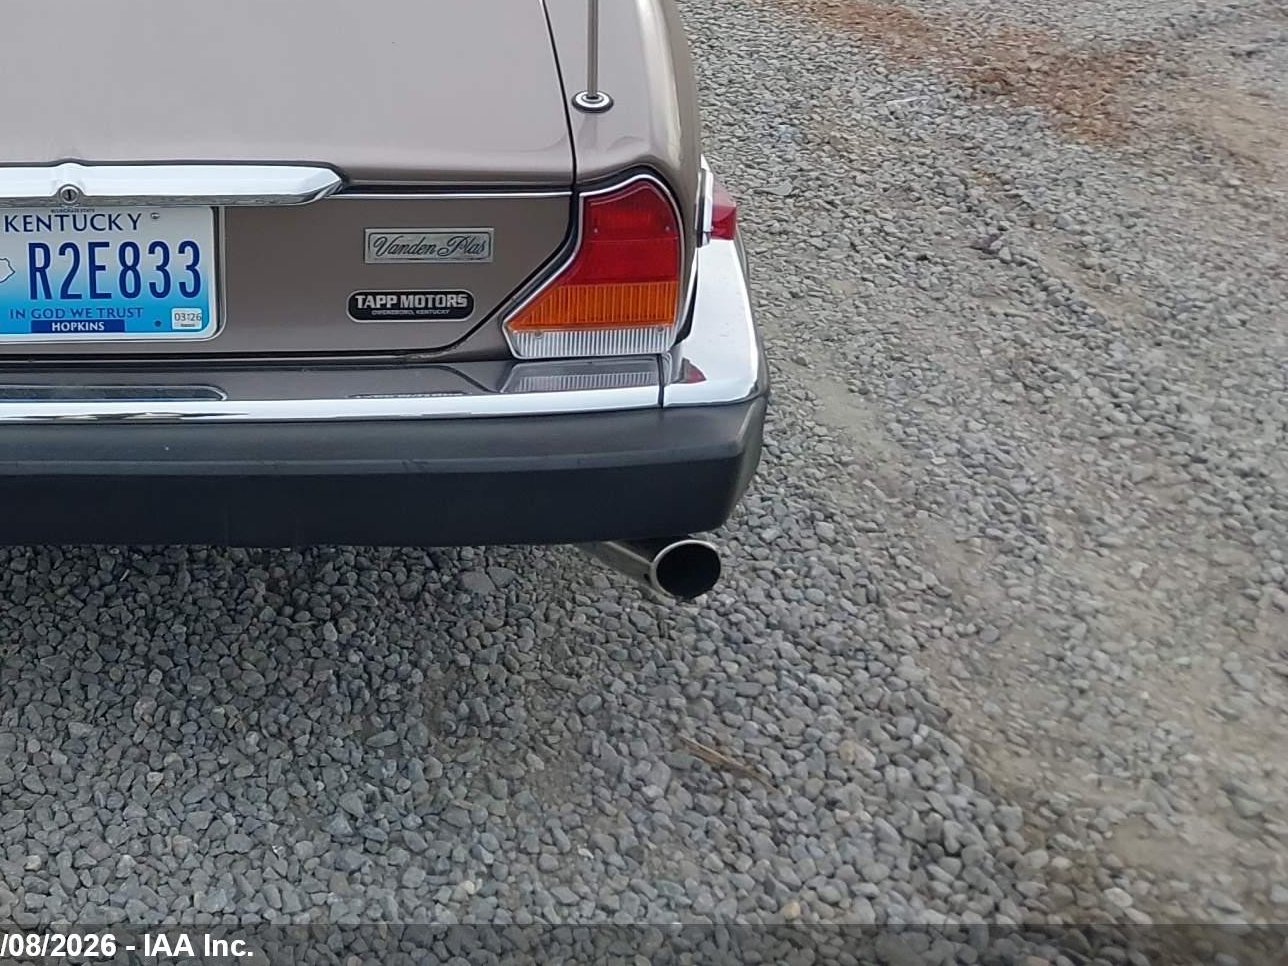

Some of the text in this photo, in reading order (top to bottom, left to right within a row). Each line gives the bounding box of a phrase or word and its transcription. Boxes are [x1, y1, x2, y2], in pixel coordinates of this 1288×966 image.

[4, 213, 142, 232] KENTUCKY
[373, 235, 486, 257] Vanden Plas
[28, 240, 202, 300] R2E833
[355, 294, 468, 309] TAPP MOTORS
[10, 307, 145, 319] IN GOD WE TRUST
[52, 321, 105, 332] HOPKINS
